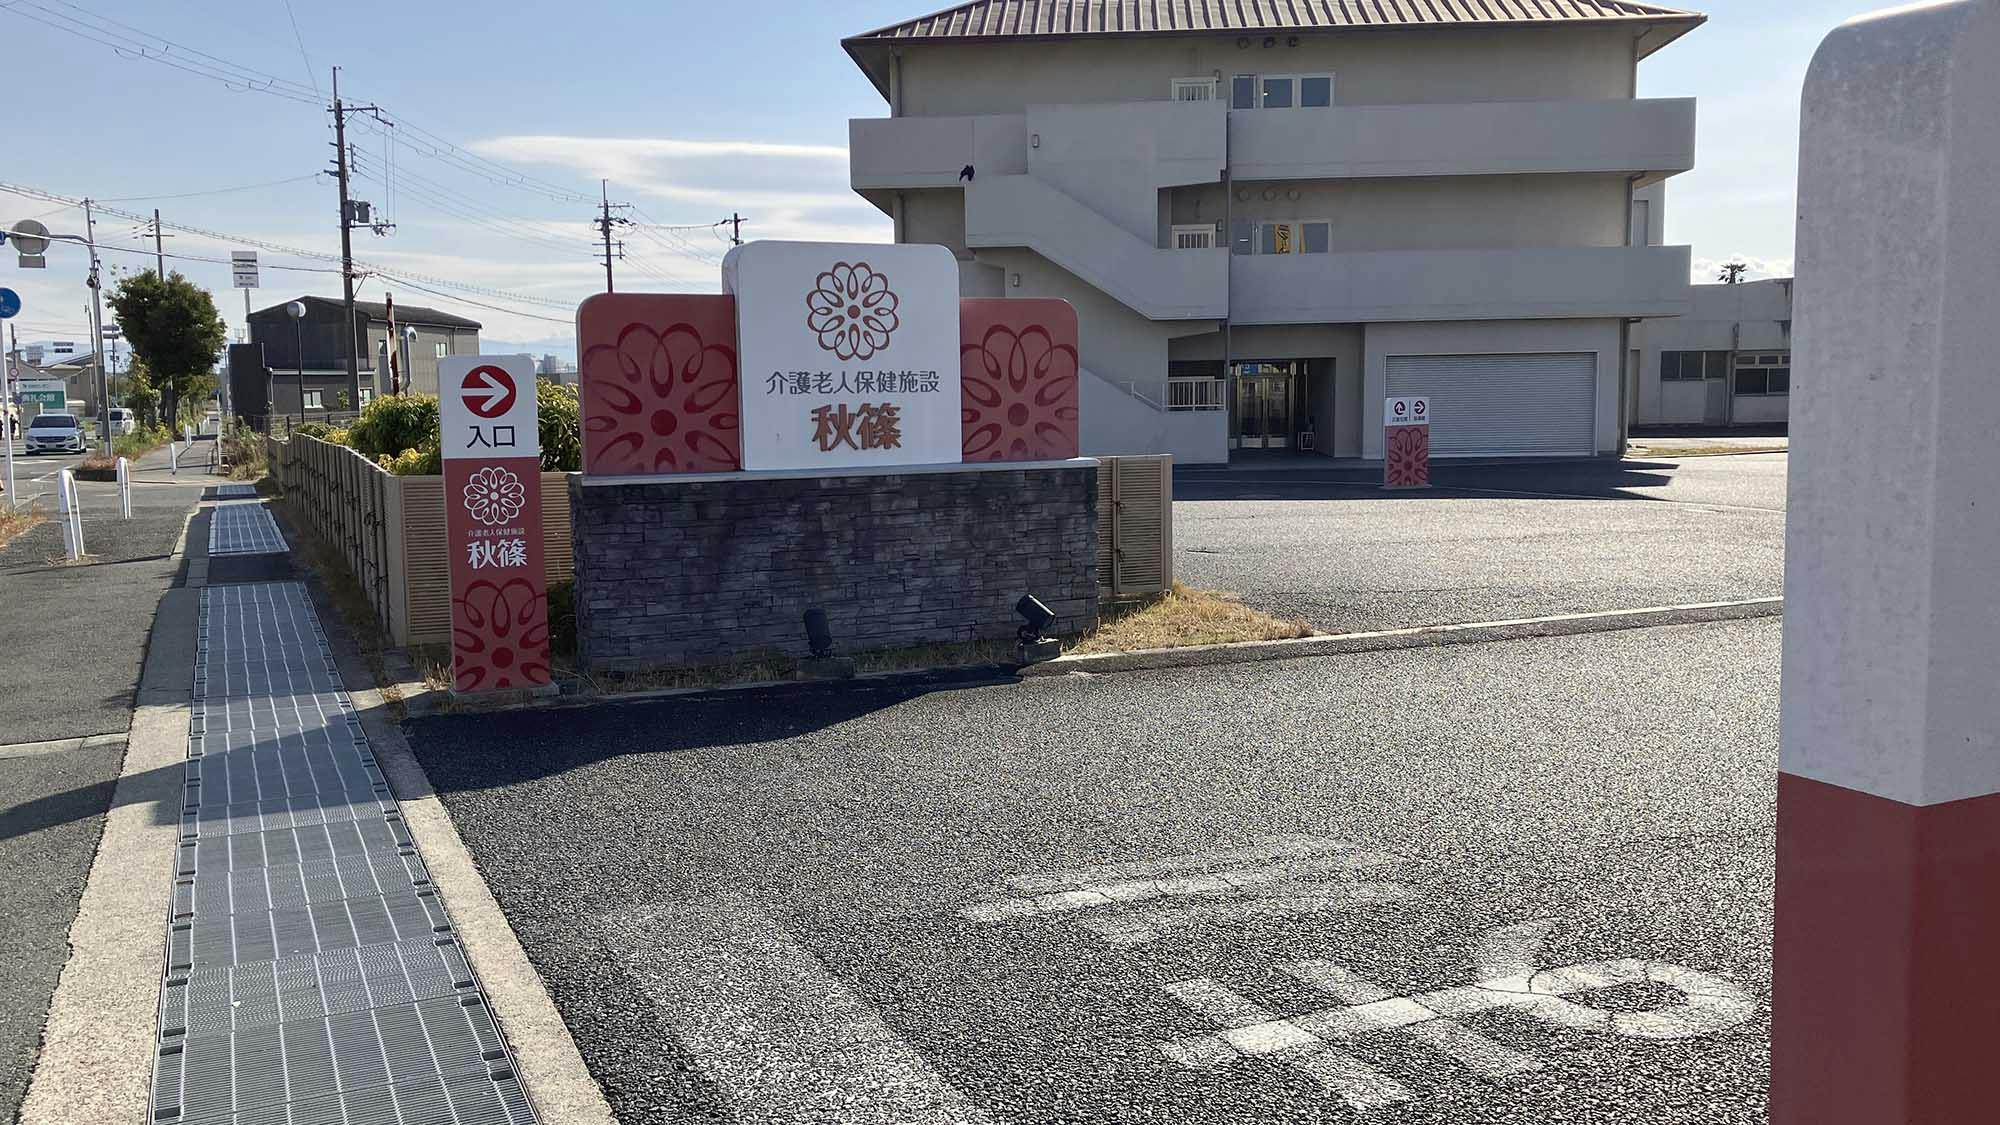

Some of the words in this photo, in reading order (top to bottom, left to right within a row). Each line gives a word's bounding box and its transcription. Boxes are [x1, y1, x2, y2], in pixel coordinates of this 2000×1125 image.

[766, 371, 940, 394] 介護老人保健施設
[466, 425, 515, 448] 入口
[811, 403, 902, 451] 秋篠
[466, 538, 528, 569] 秋篠
